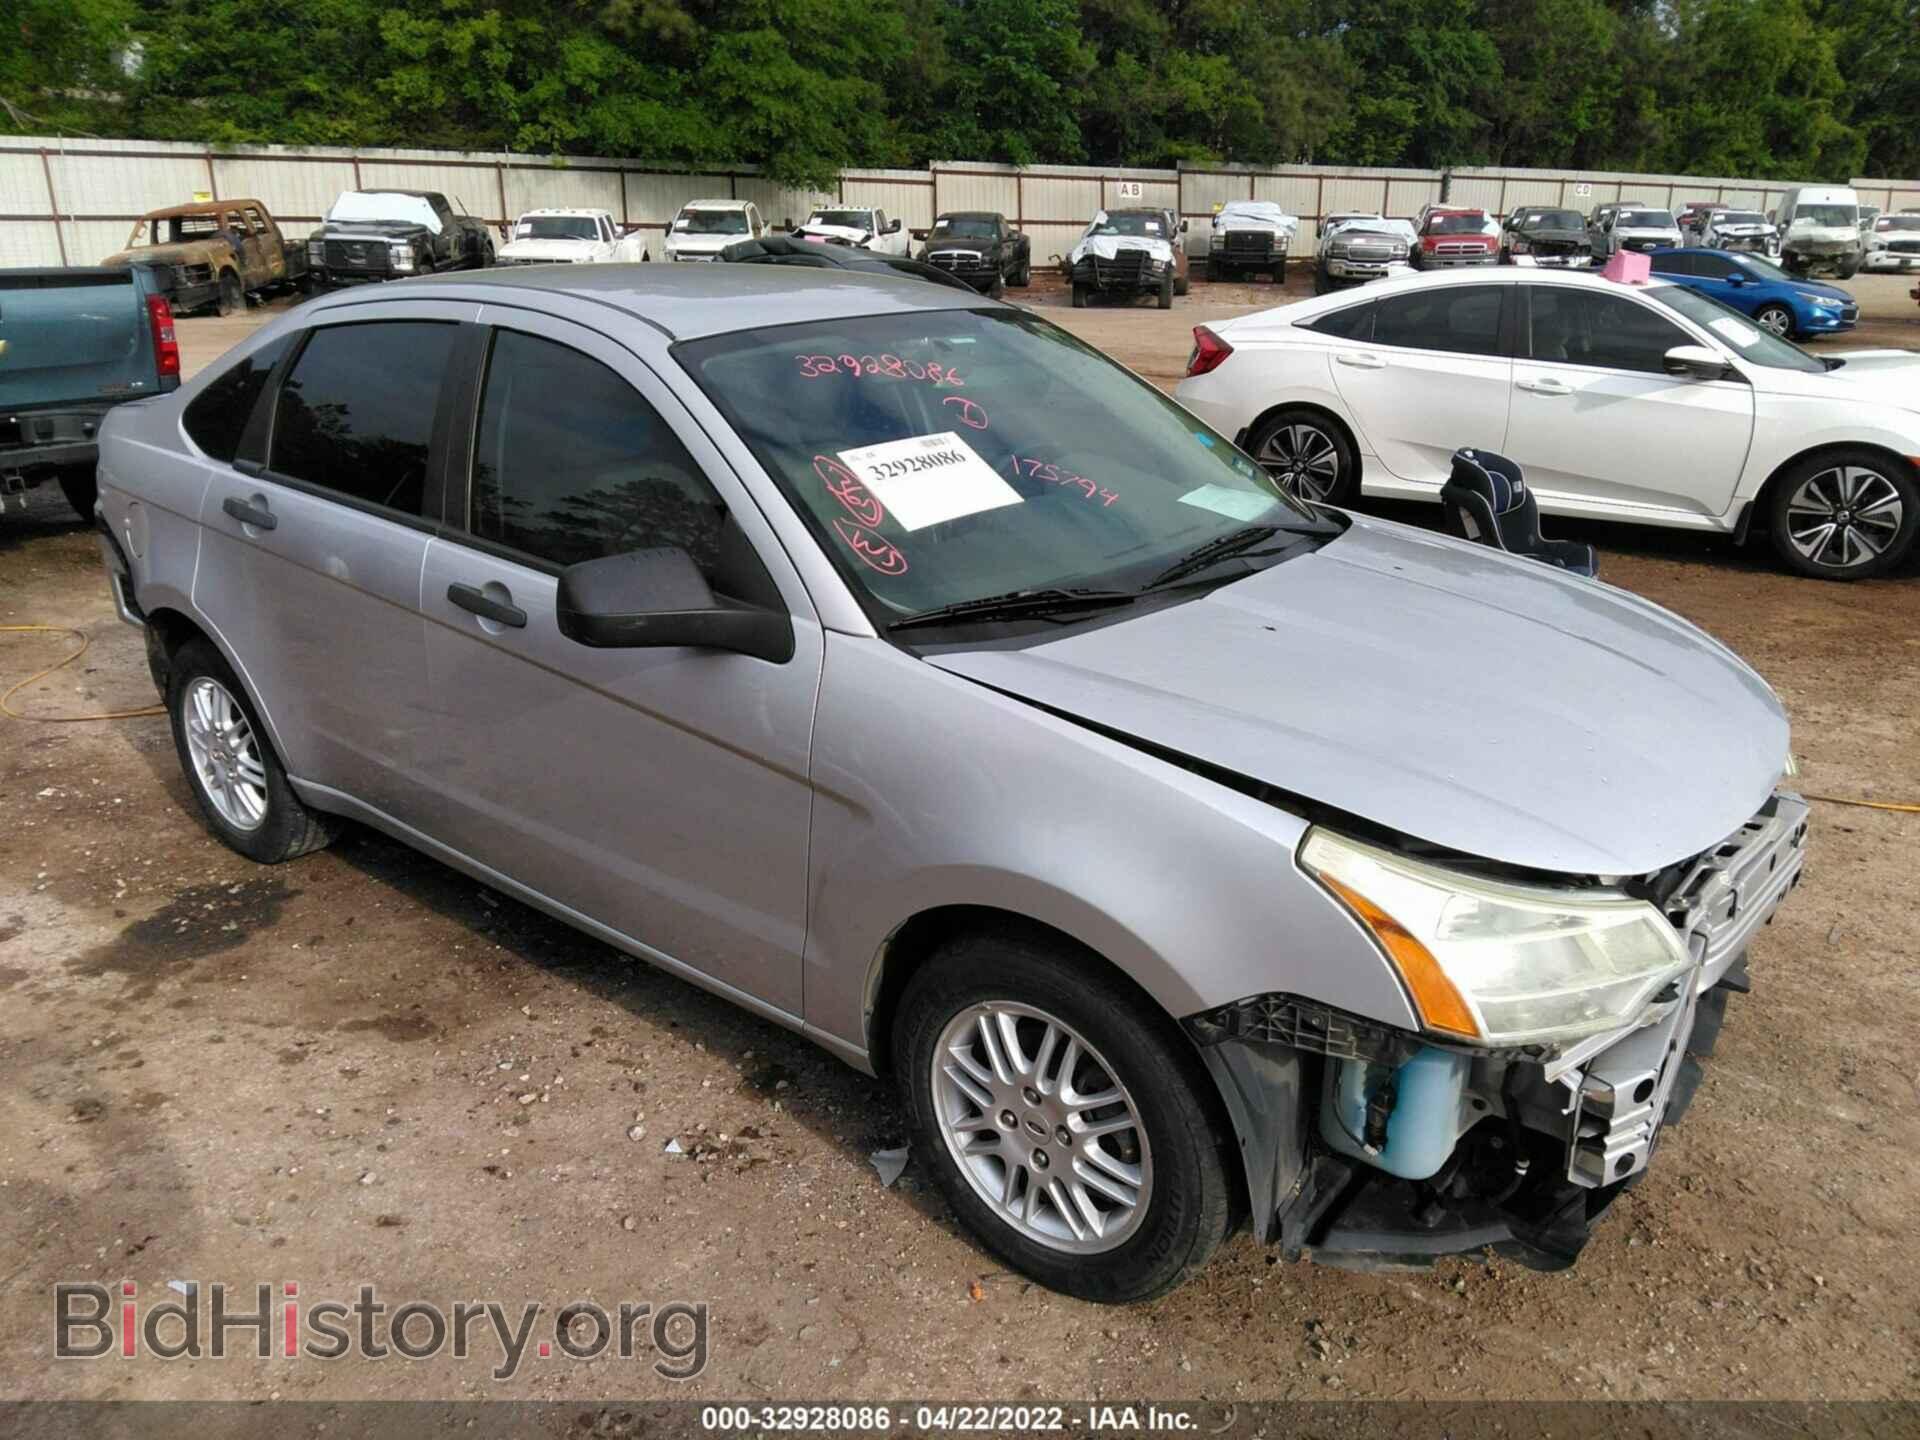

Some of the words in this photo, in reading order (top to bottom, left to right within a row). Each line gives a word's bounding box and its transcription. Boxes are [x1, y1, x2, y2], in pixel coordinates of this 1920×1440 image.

[795, 353, 966, 387] 32928086
[868, 449, 966, 481] 32928086
[1010, 453, 1120, 508] 175794
